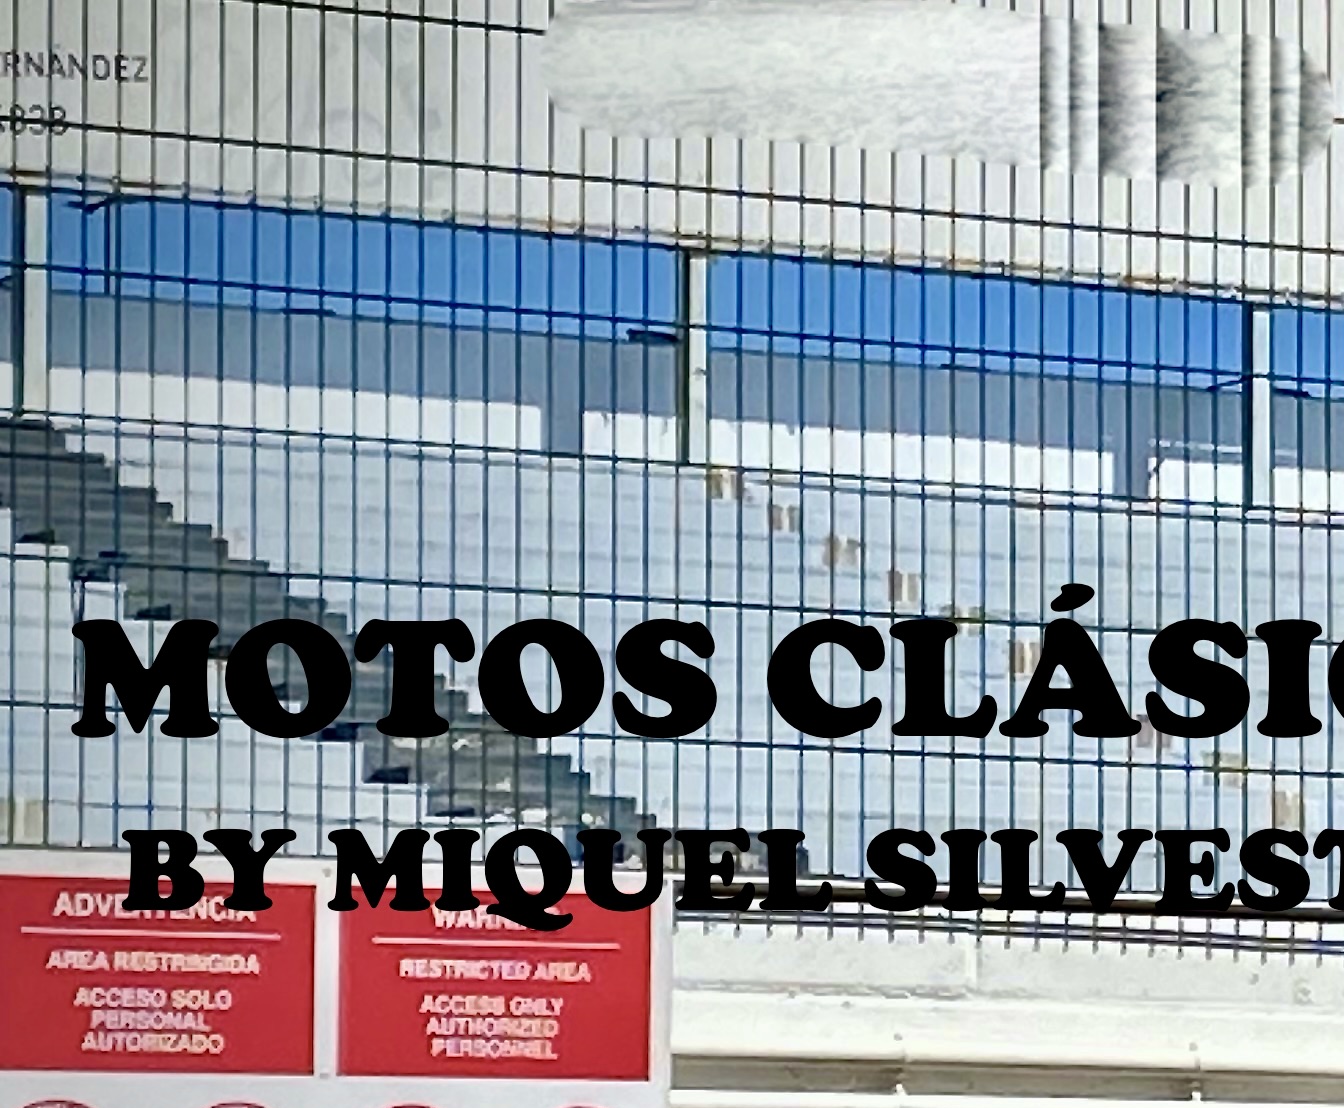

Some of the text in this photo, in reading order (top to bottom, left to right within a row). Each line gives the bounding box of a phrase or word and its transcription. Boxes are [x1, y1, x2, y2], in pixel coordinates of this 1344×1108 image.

[0, 43, 149, 82] RNÁNDEZ
[400, 958, 591, 983] RESTRICTED AREA
[73, 987, 233, 1011] ACCESO SOLO
[419, 994, 564, 1017] ACCESS ONLY
[90, 1009, 212, 1033] PERSONAL
[81, 1031, 225, 1055] AUTORIZADO
[430, 1038, 559, 1061] PERSONNEL
